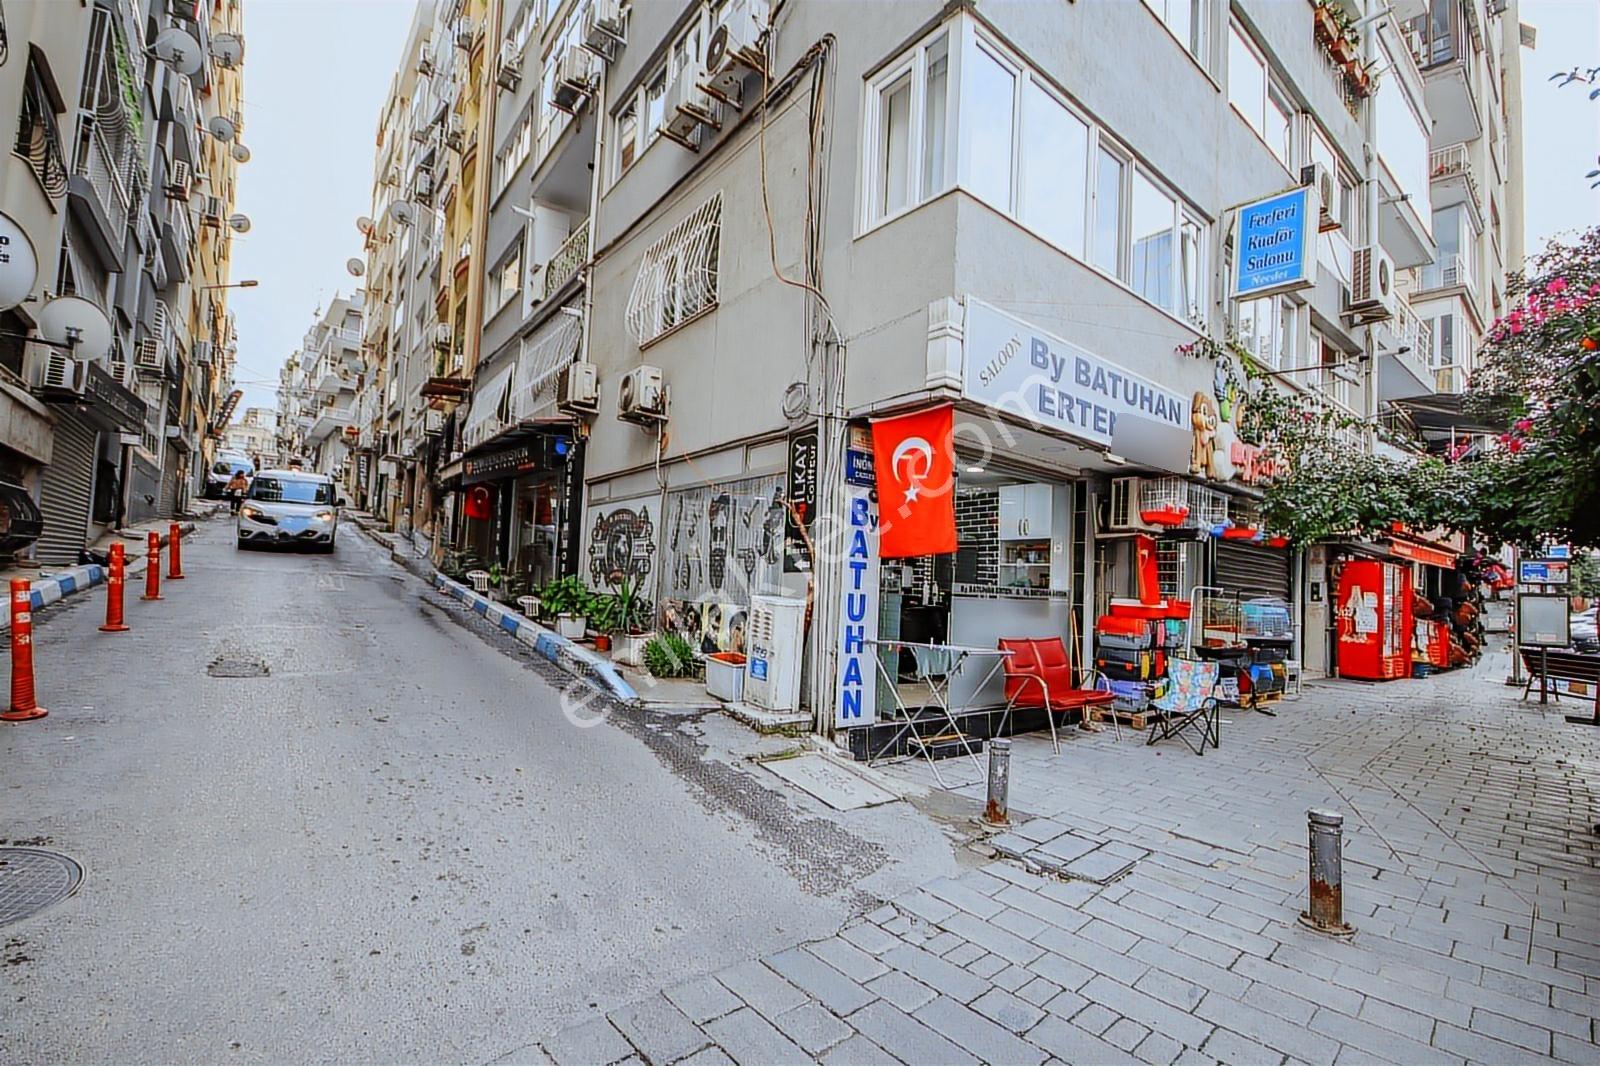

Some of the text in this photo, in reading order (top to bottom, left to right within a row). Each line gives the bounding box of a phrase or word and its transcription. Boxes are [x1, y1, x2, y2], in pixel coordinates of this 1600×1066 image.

[1249, 203, 1296, 229] Ferferi
[1248, 227, 1295, 251] Kuaför
[1247, 251, 1294, 272] Salonu
[979, 333, 1022, 388] SALOON
[1030, 336, 1182, 425] By BATUHAN
[842, 498, 869, 720] BATUHAN
